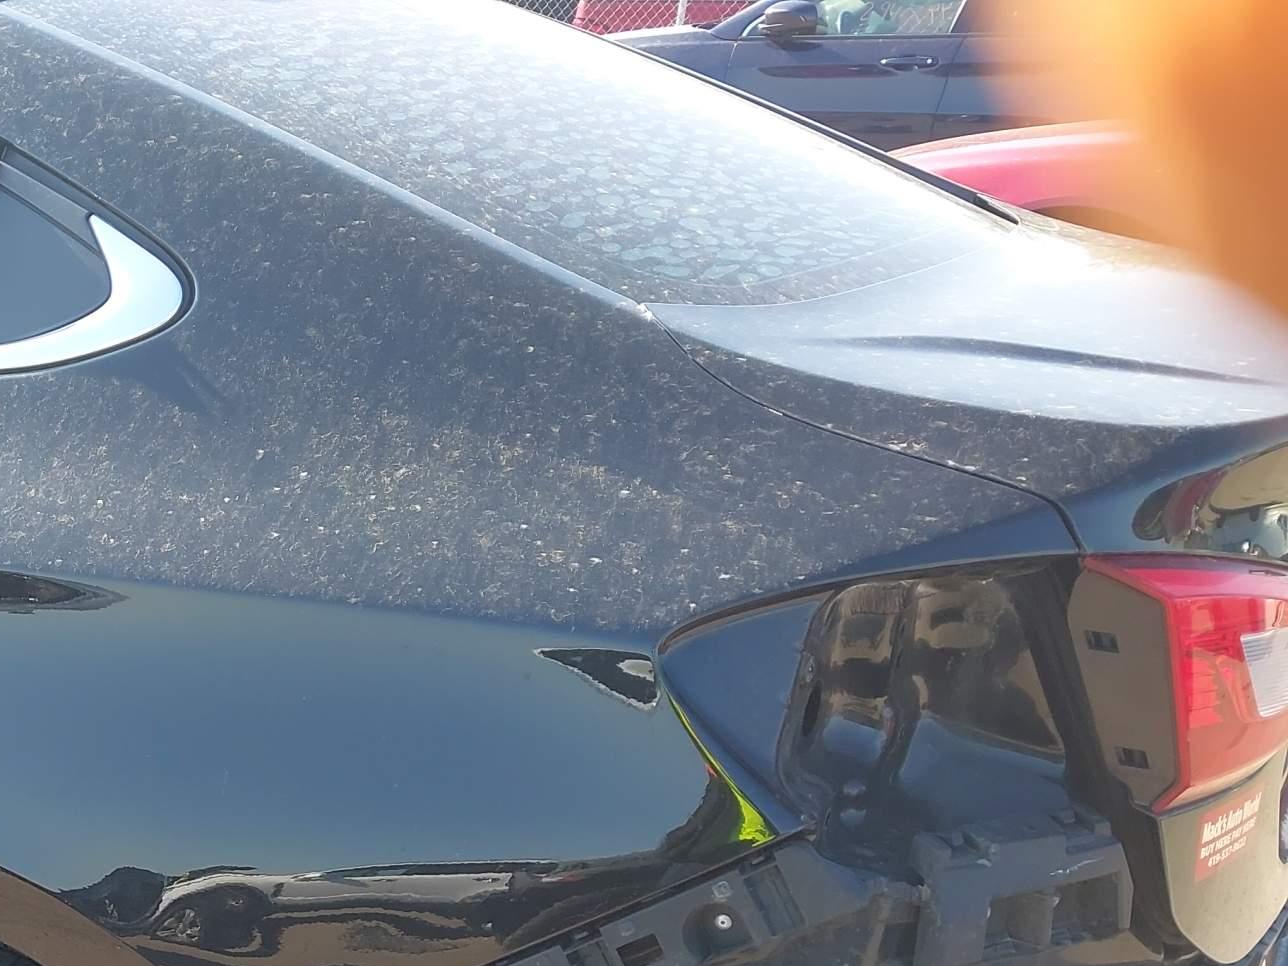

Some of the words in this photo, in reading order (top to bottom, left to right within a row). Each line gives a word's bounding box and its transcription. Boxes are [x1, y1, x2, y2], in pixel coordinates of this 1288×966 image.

[1225, 807, 1244, 831] Auto
[1200, 841, 1216, 860] BUY
[1215, 832, 1232, 850] HERE
